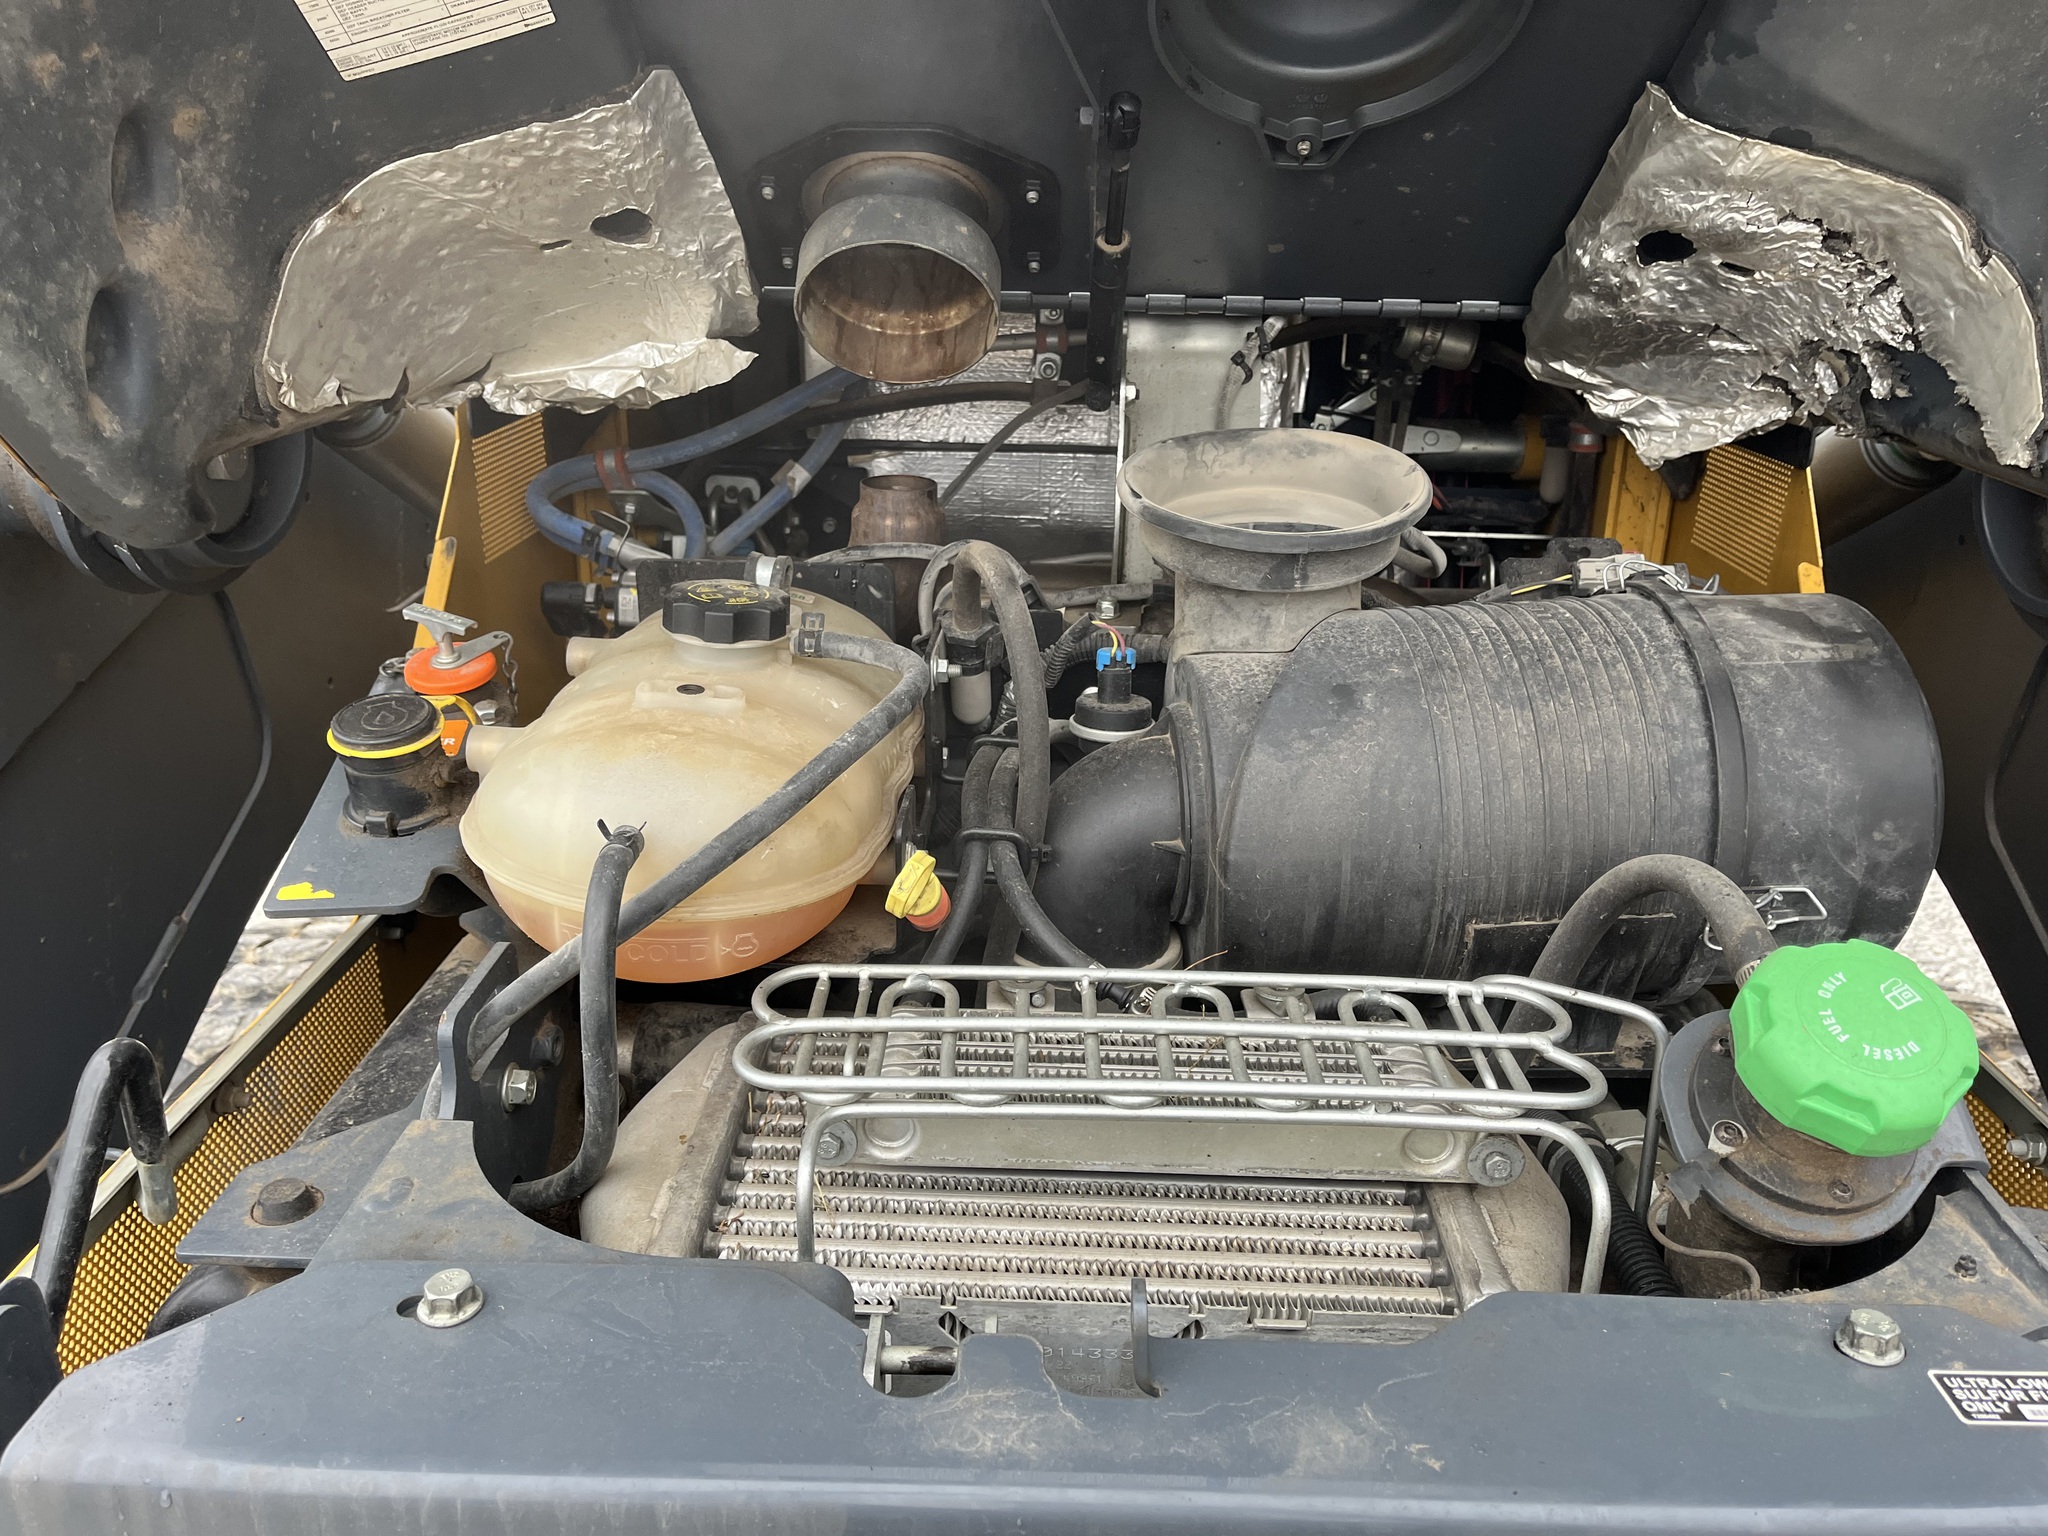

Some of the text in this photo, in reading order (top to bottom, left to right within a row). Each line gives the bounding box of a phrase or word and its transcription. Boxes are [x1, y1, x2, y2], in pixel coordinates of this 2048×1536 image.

[1817, 971, 1920, 1061] DIESEL FUEL ONLY
[1942, 1376, 2007, 1389] ULTRA
[1951, 1388, 2030, 1401] SULFUR
[1961, 1400, 2012, 1414] ONLY
